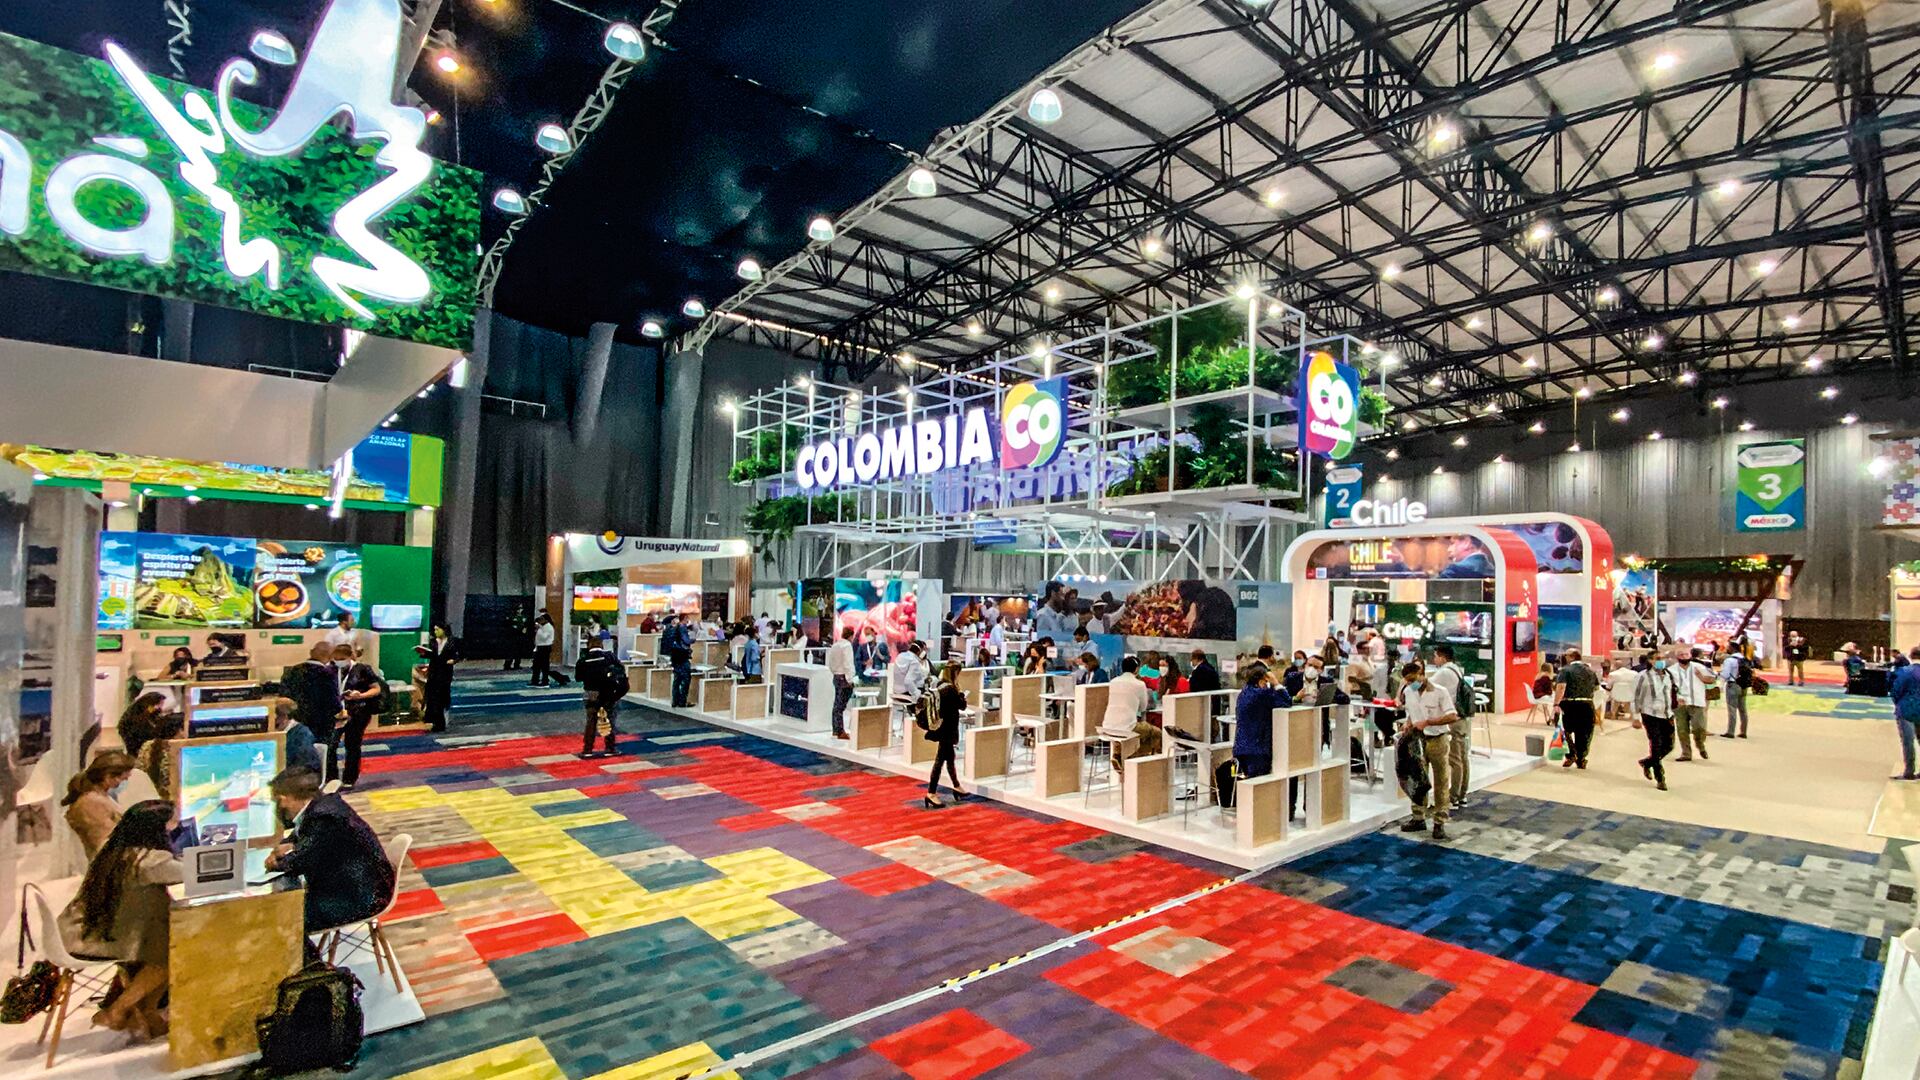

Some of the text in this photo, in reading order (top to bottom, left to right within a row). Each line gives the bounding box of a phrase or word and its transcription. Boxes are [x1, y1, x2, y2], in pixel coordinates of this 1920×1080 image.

[1312, 372, 1353, 425] CO
[796, 407, 994, 489] COLOMBIA
[1005, 398, 1061, 450] CO
[1757, 473, 1781, 500] 3
[1336, 488, 1350, 508] 2
[1350, 497, 1428, 526] Chile
[143, 552, 202, 564] Despierta tu
[1349, 541, 1393, 564] CHILE
[142, 569, 186, 578] aventura
[181, 562, 194, 571] de
[1383, 622, 1423, 639] Chile
